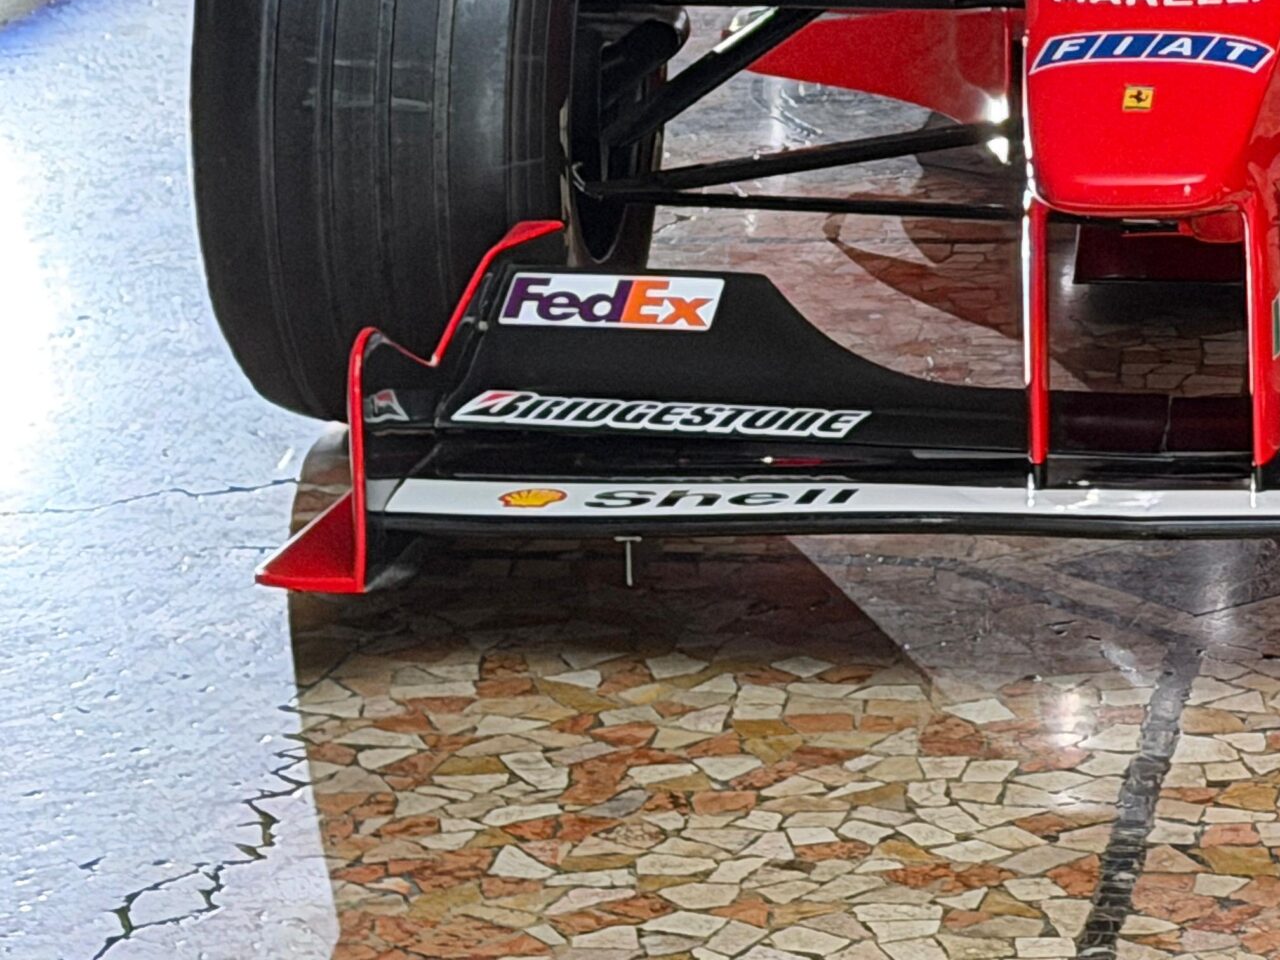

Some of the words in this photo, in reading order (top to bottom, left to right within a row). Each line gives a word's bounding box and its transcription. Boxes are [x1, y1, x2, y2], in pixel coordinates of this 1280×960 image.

[1050, 36, 1258, 63] FIAT
[502, 277, 711, 328] FedEx
[452, 390, 872, 439] BRIDGESTONE
[584, 488, 860, 508] Shell
